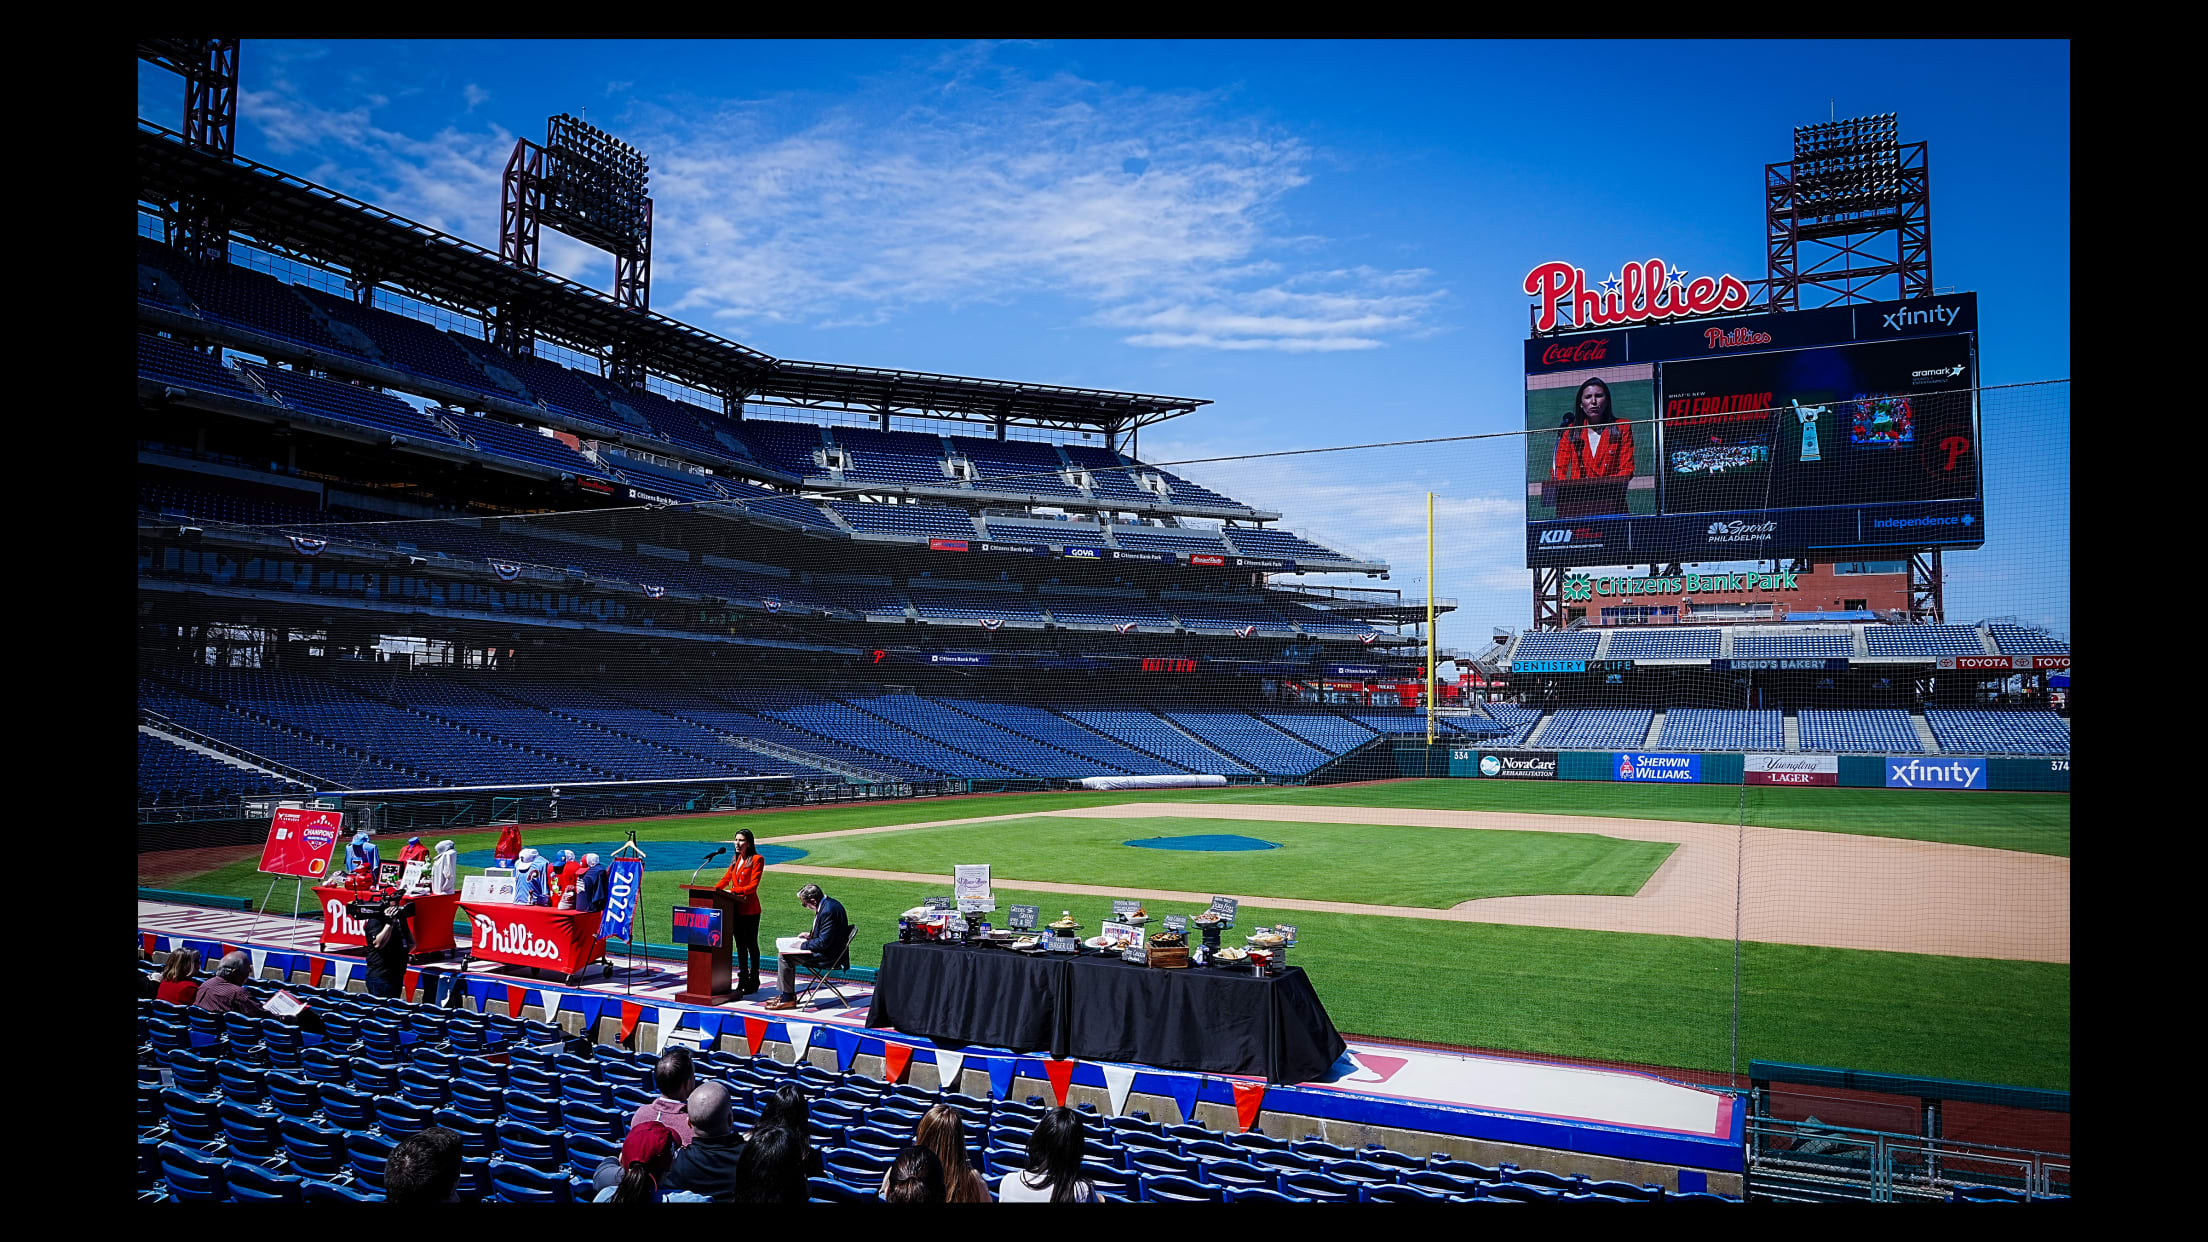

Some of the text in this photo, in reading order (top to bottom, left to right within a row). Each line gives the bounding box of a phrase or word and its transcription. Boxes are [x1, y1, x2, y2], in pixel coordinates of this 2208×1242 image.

[1523, 258, 1749, 331] Phillies
[1883, 304, 1960, 331] xfinity
[1704, 327, 1771, 349] Phillies
[1912, 367, 1950, 377] aramark
[1666, 392, 1772, 427] CELEBRATIONS
[637, 491, 679, 505] Citizens Bank Park
[1727, 520, 1777, 534] Sports
[1874, 517, 1958, 529] Independence
[1708, 533, 1772, 543] PHILADELPHIA
[1597, 569, 1798, 595] Citizens Bank Park
[1513, 661, 1582, 671] DENTISTRY
[1604, 660, 1631, 671] LIFE
[1731, 660, 1826, 670] LISCIO'S BAKERY
[1959, 658, 2009, 667] TOYOTA
[1454, 751, 1469, 760] 334
[1637, 755, 1690, 768] SHERWIN
[1501, 757, 1556, 770] NovaCare
[2051, 760, 2070, 771] 374
[1771, 773, 1809, 782] LAGER
[1892, 760, 1980, 788] xfinity
[605, 871, 634, 923] 2022
[474, 913, 559, 960] Phillies
